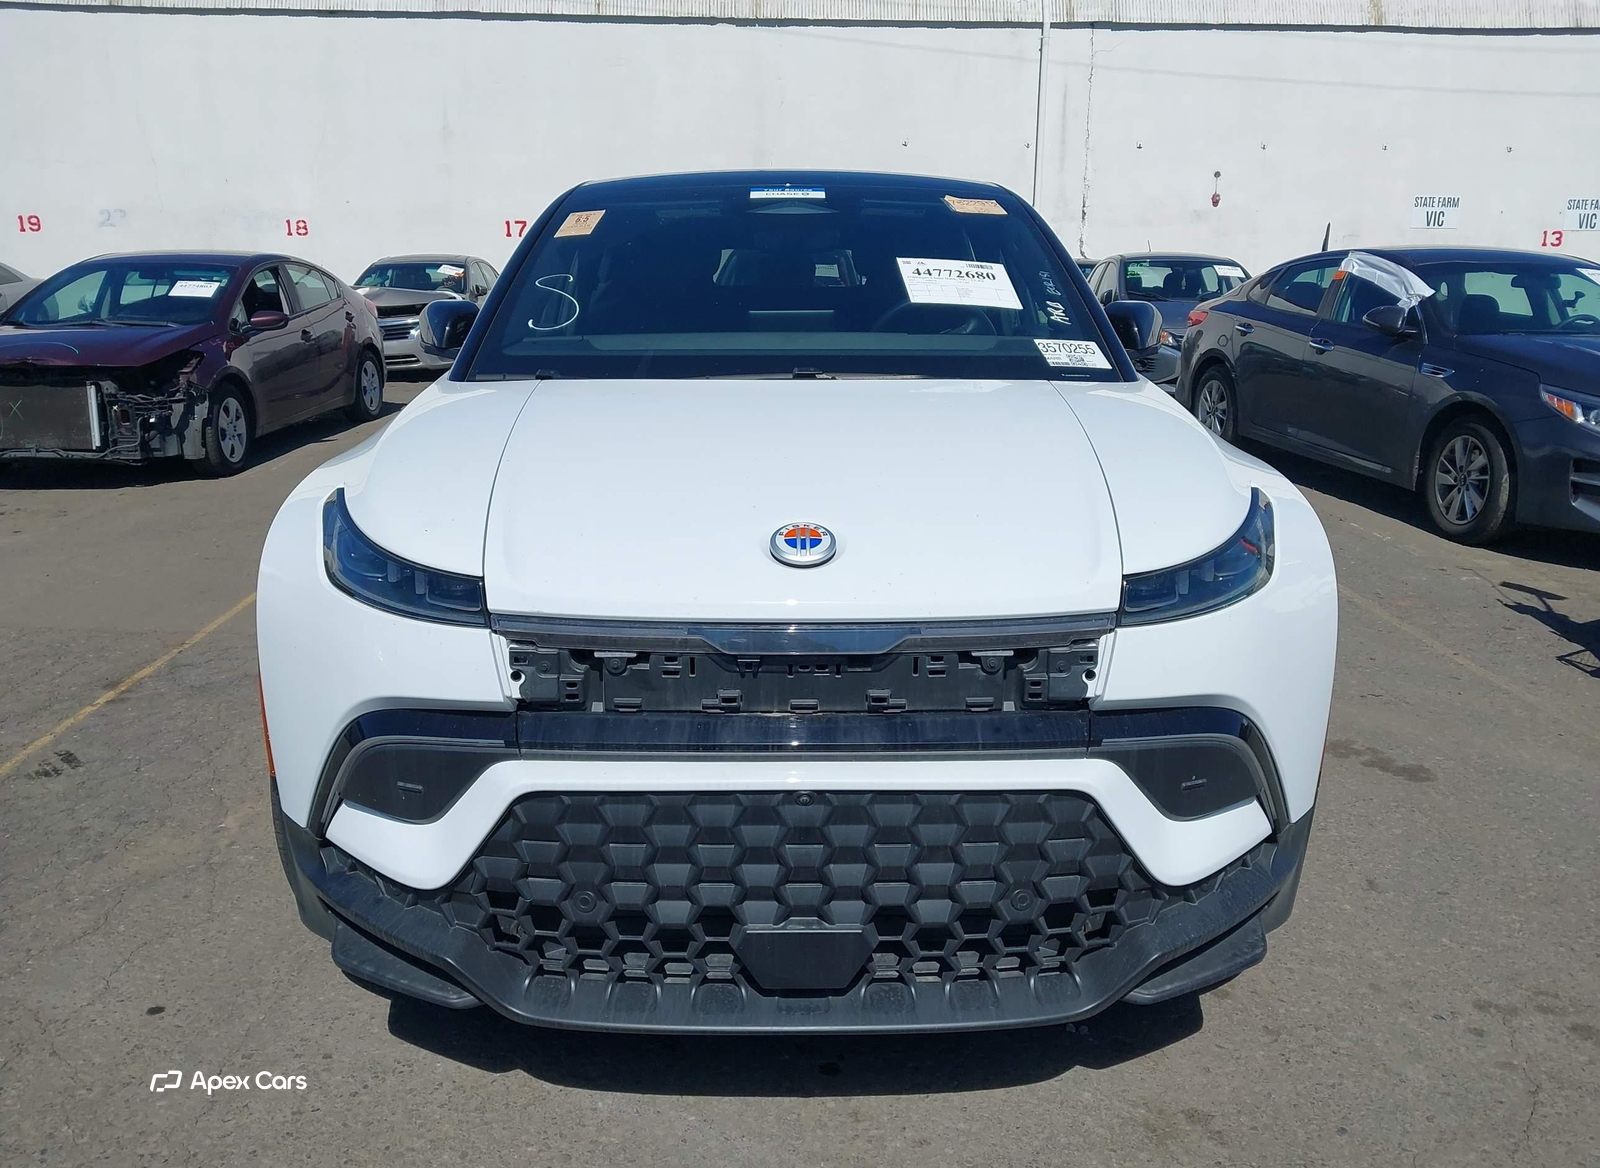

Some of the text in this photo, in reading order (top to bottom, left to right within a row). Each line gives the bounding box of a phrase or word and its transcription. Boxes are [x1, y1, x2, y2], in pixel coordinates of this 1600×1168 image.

[1414, 196, 1460, 208] STATE FARM
[1567, 199, 1600, 211] STATE FA
[17, 214, 42, 233] 19
[1426, 210, 1445, 227] VIC
[1578, 213, 1598, 229] VIC
[285, 219, 309, 237] 18
[505, 220, 527, 238] 17
[1541, 230, 1564, 247] 13
[912, 267, 996, 281] 44772680
[1037, 342, 1097, 355] 3570255
